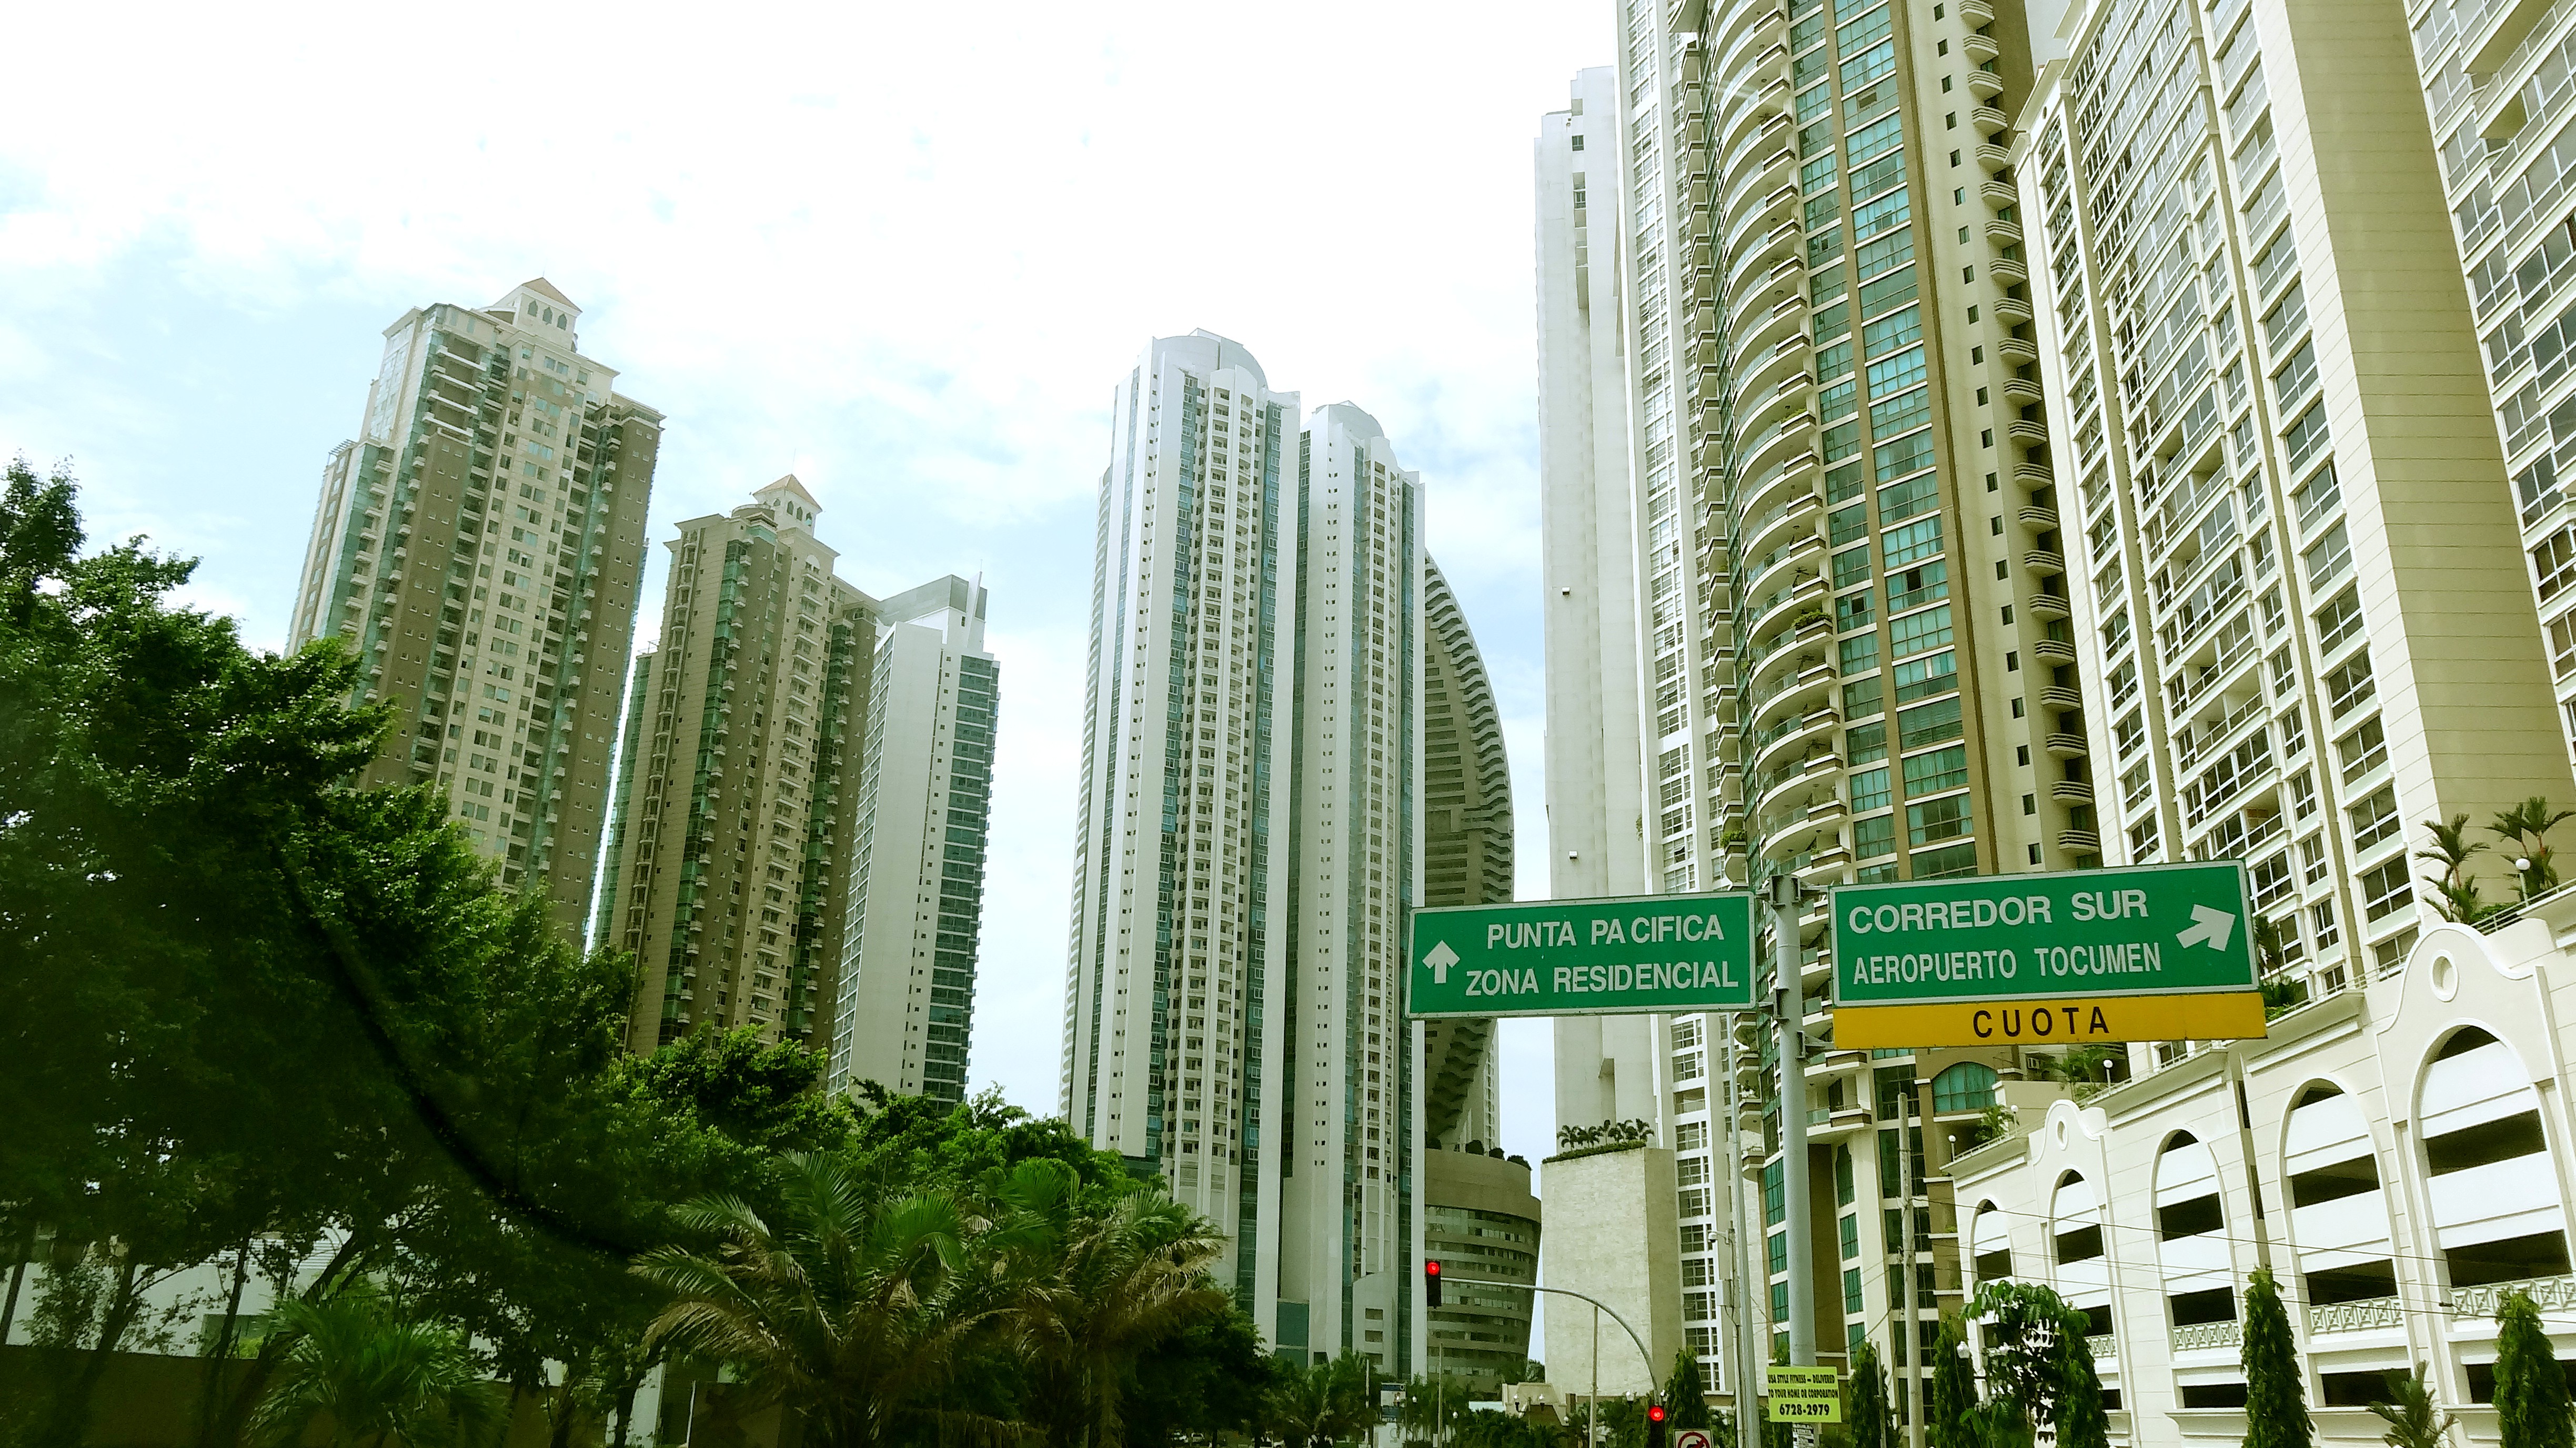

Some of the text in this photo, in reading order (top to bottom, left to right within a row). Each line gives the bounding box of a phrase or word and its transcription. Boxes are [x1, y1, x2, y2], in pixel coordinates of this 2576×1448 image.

[1849, 889, 2149, 934] CORREDOR SUR
[1487, 921, 1577, 950] PUNTA
[1465, 960, 1739, 996] ZONA RESIDENCIAL
[1853, 942, 2162, 985] AEROPUERTO TOCUMEN
[1973, 1006, 2110, 1038] CUOTA
[1767, 1374, 1777, 1384] USA
[1777, 1374, 1789, 1384] STYLE
[1789, 1374, 1806, 1384] FITNESS
[1812, 1374, 1835, 1384] DELIVERED
[1768, 1388, 1774, 1398] TO
[1774, 1388, 1787, 1399] YOUR
[1800, 1388, 1807, 1399] OR
[1808, 1388, 1838, 1399] CORPORATION
[1779, 1404, 1830, 1416] 6728-2979
